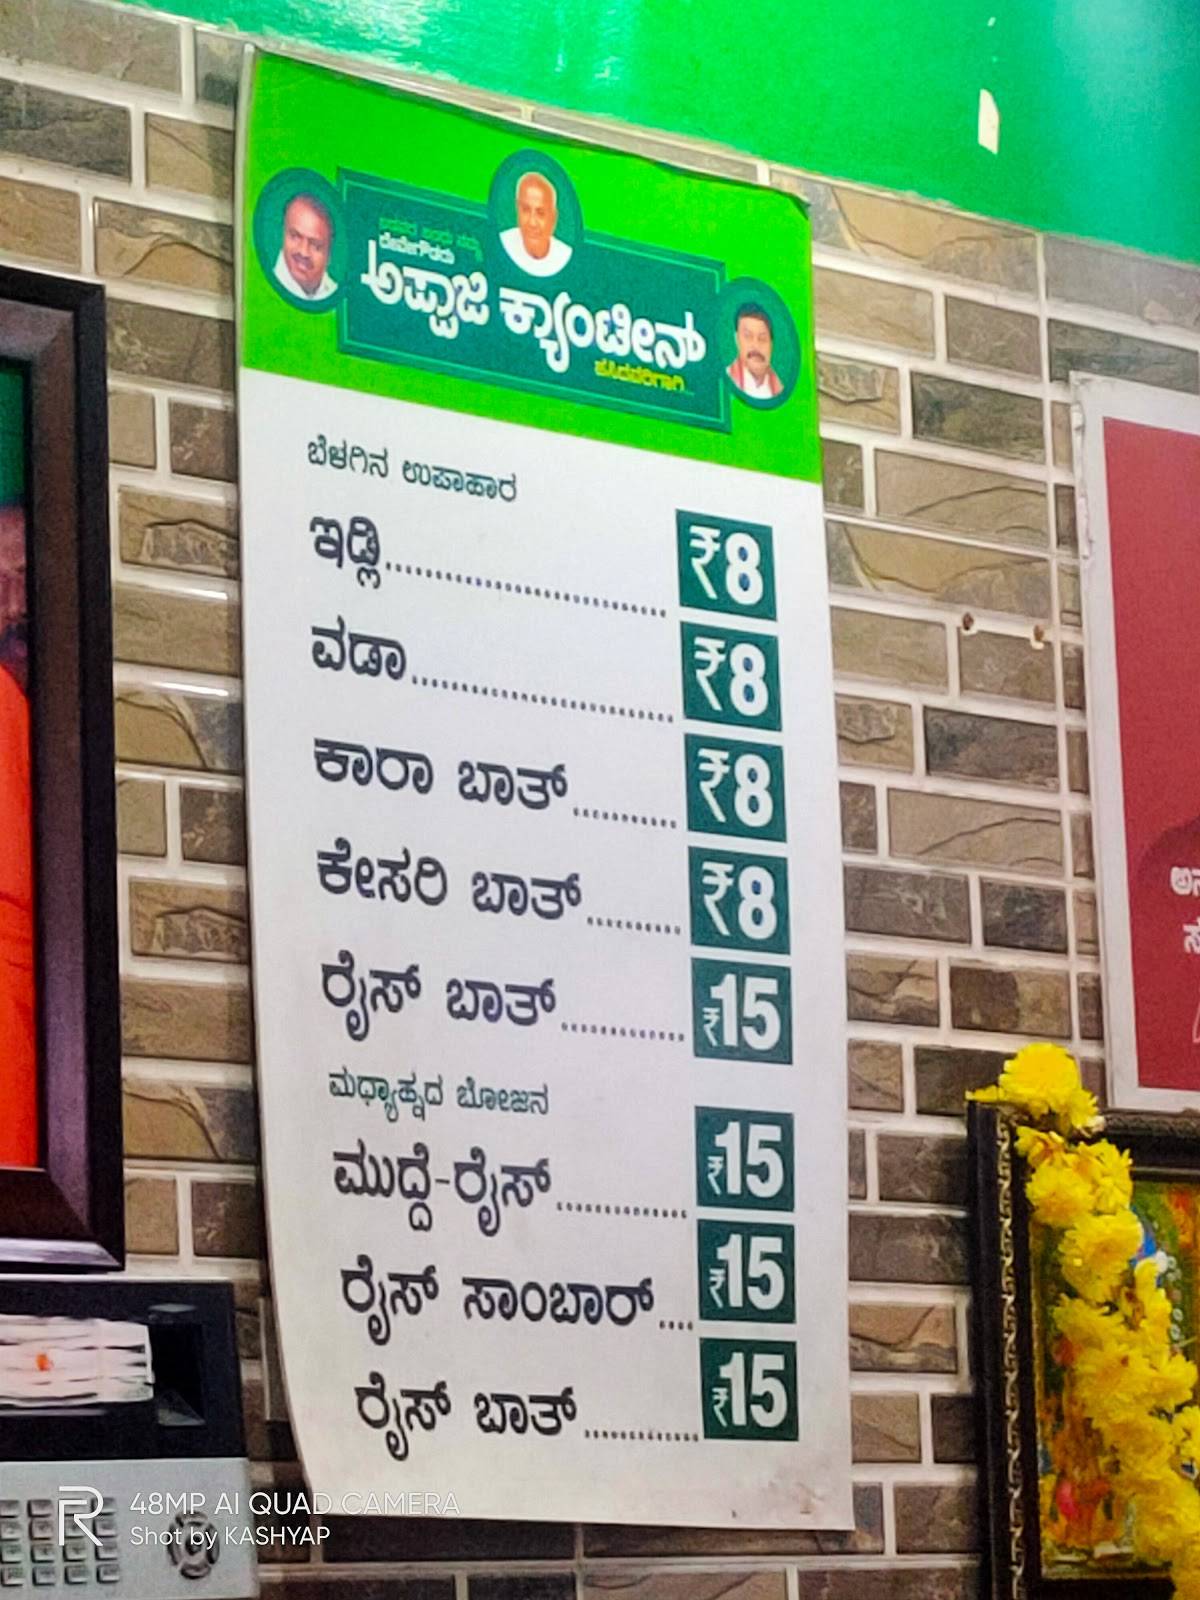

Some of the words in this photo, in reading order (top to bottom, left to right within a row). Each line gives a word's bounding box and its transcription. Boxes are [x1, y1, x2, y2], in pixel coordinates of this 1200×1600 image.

[361, 239, 490, 340] ಅಪ್ಪಾಜಿ
[499, 287, 707, 374] ಕ್ಯಾಂಟೀನ್
[307, 433, 390, 480] ಬೆಳಗಿನ
[401, 459, 518, 504] ಉಪಾಹಾರ
[309, 515, 381, 590] ಇಡ್ಲಿ
[690, 524, 764, 606] ₹8
[311, 614, 407, 681] ವಡಾ
[694, 636, 769, 717] ₹8
[313, 737, 434, 795] ಕಾರಾ
[457, 760, 569, 811] ಬಾತ್
[698, 748, 774, 827] ₹8
[316, 836, 449, 907] ಕೇಸರಿ
[471, 870, 583, 921] ಬಾತ್
[702, 861, 777, 940] ₹8
[321, 949, 422, 1043] ರೈಸ್
[445, 977, 557, 1027] ಬಾತ್
[703, 973, 781, 1051] ₹15
[328, 1065, 444, 1124] ಮಧ್ಯಾಹ್ನದ
[332, 1138, 552, 1238] ಮುದ್ದೆ-ರೈಸ್
[708, 1121, 784, 1198] ₹15
[340, 1254, 440, 1347] ರೈಸ್
[461, 1276, 656, 1328] ಸಾಂಬಾರ್
[710, 1234, 785, 1310] ₹15
[353, 1371, 452, 1462] ರೈಸ್
[473, 1386, 578, 1437] ಬಾತ್
[713, 1352, 787, 1427] ₹15
